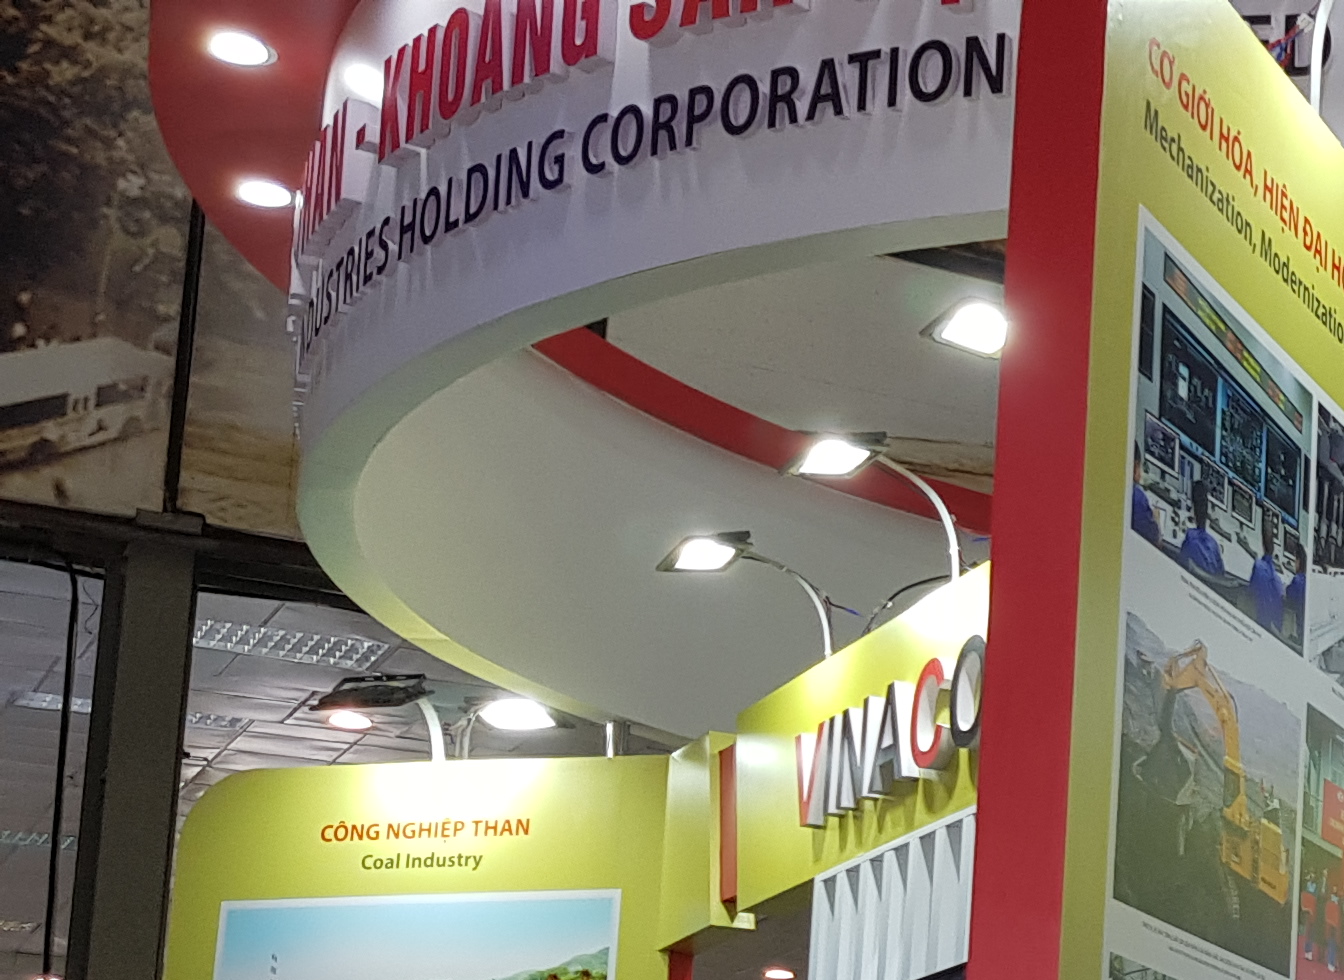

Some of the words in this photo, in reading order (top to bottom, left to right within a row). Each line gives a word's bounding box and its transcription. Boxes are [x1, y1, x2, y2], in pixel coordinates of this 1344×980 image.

[398, 129, 565, 260] HOLDING
[581, 33, 1007, 174] CORPORATION
[1144, 99, 1257, 254] Mechanization,
[1148, 37, 1175, 90] CƠ
[1177, 72, 1214, 141] GIỚI
[1219, 116, 1258, 197] HÓA,
[1263, 168, 1300, 239] HIỆN
[1303, 216, 1328, 273] ĐẠI
[320, 820, 380, 842] CÔNG
[386, 818, 465, 843] NGHIỆP
[471, 818, 530, 836] THAN
[361, 853, 400, 870] Coal
[405, 852, 483, 871] Industry
